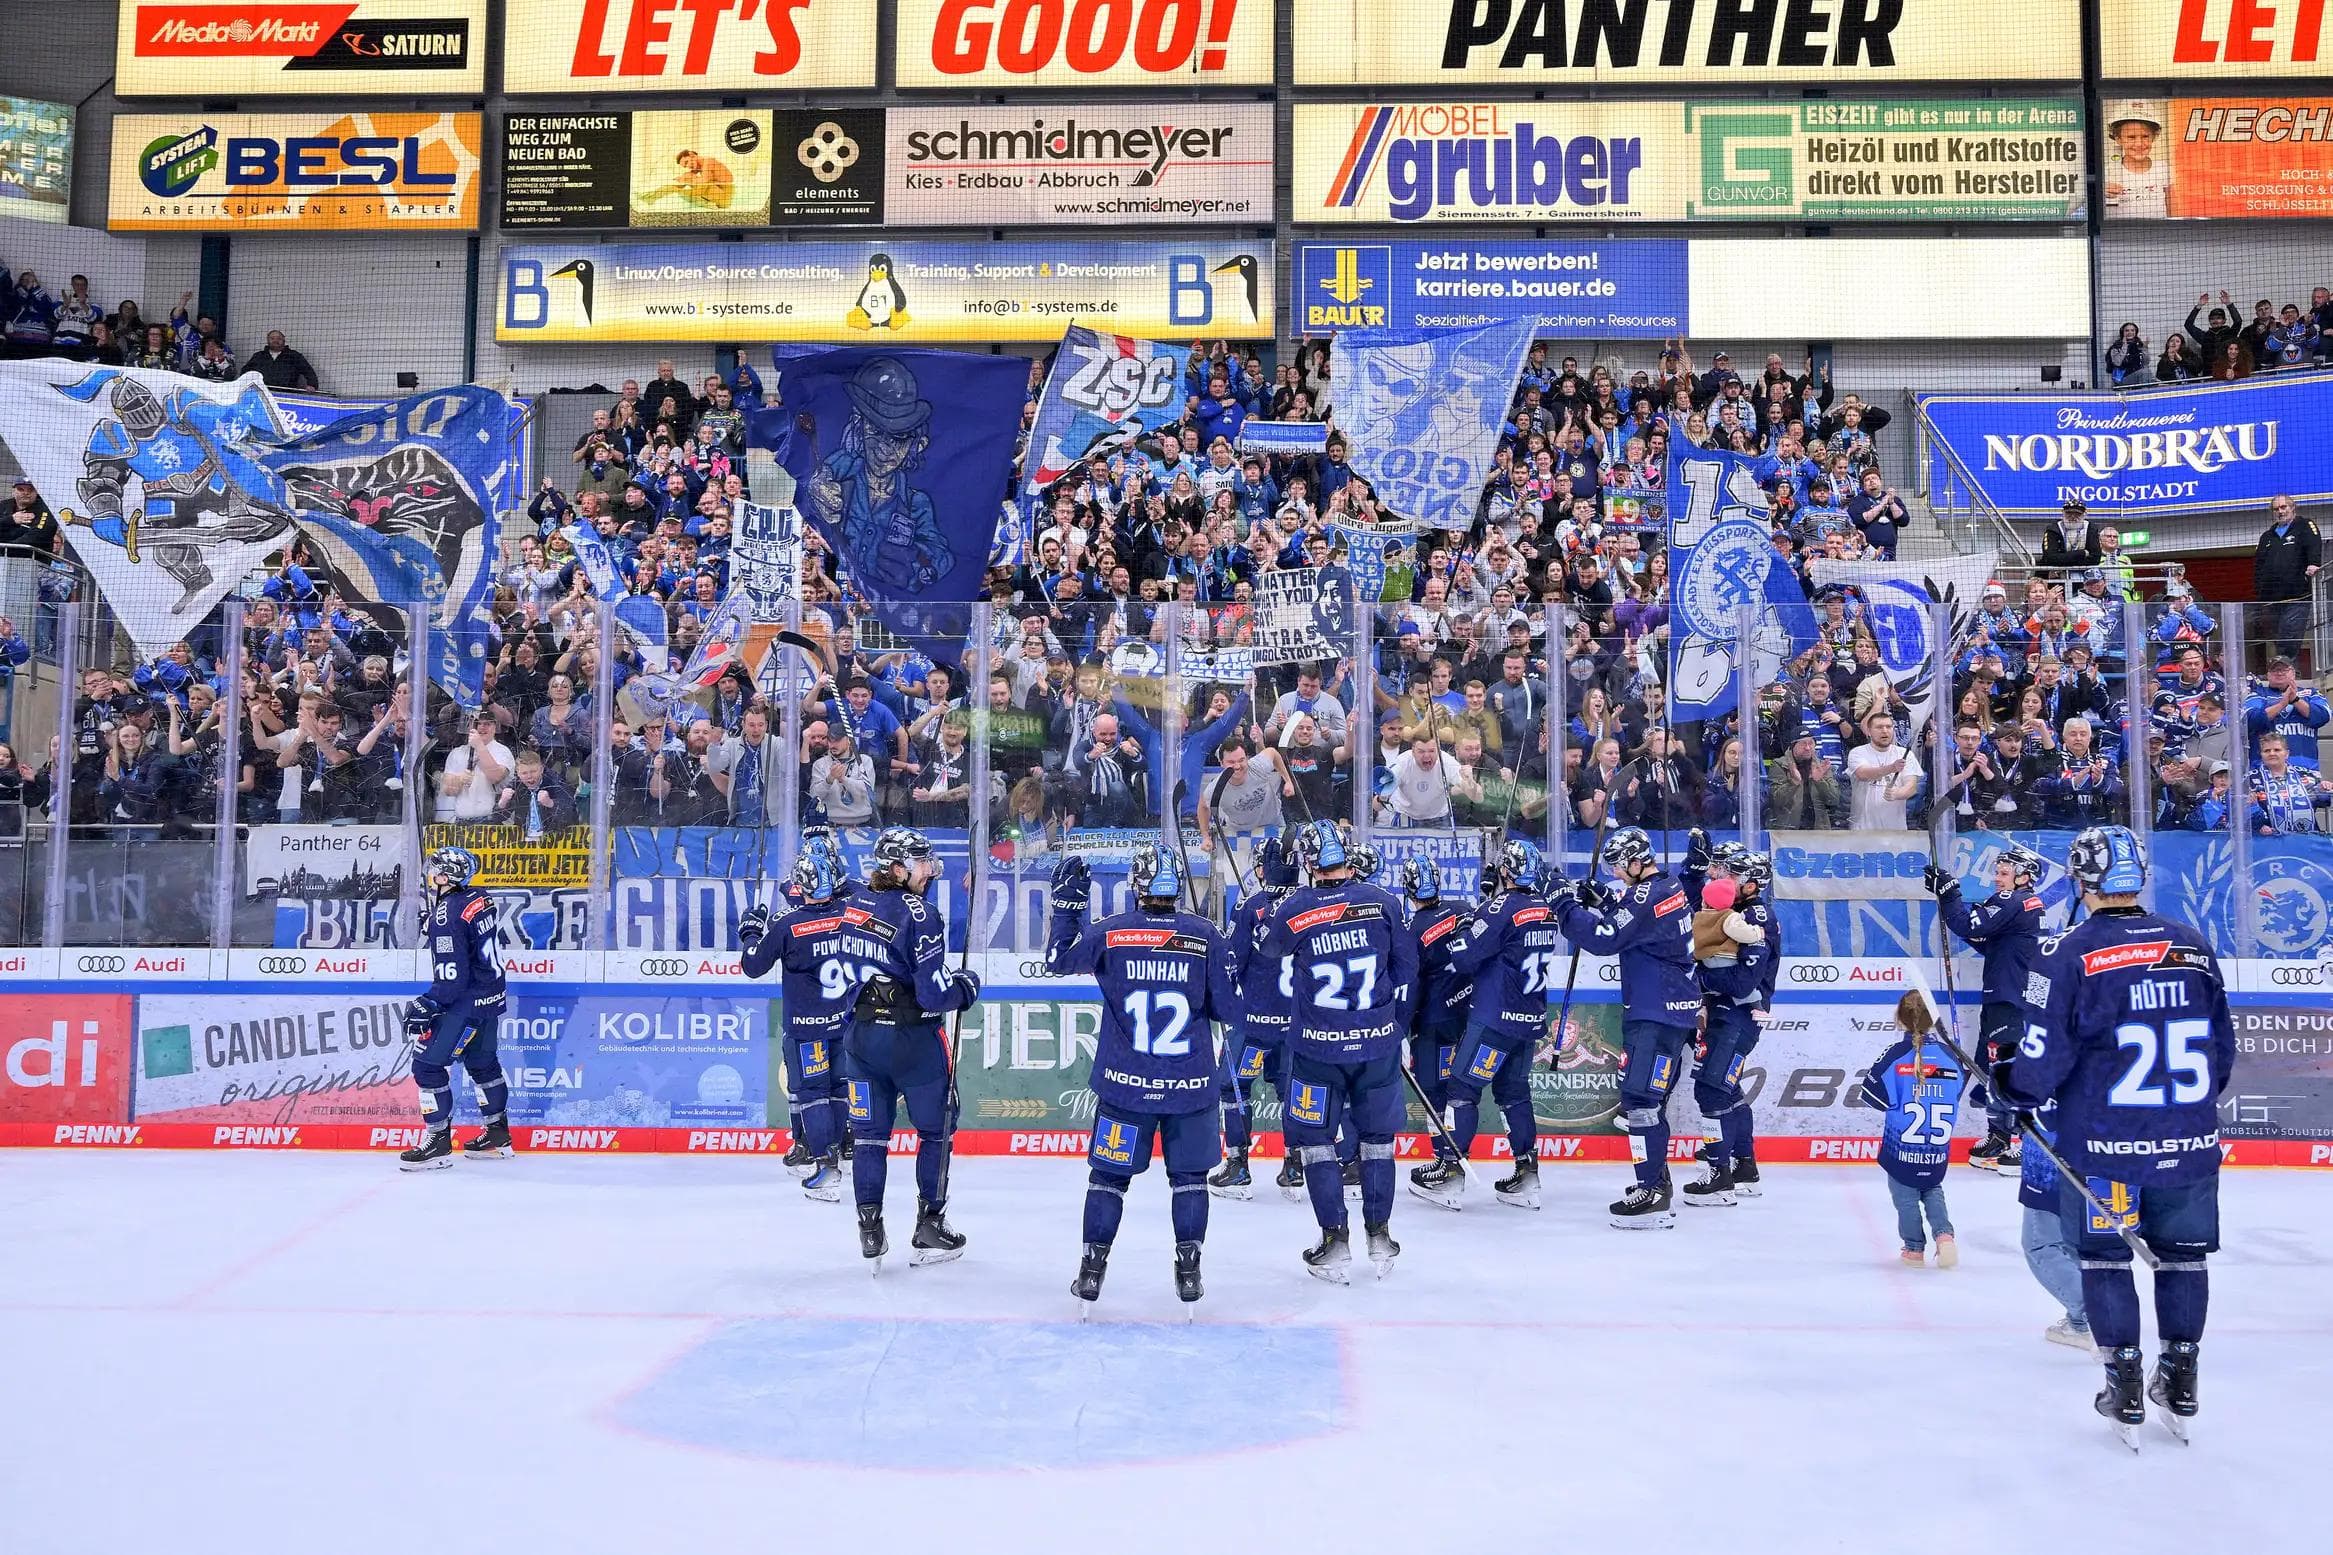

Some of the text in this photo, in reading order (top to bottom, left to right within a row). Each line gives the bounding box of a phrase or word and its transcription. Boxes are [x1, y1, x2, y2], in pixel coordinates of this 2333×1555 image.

[382, 33, 462, 57] SATURN
[570, 0, 810, 77] LET'S
[931, 0, 1236, 75] GOOO!
[1441, 0, 1904, 69] PANTHER
[509, 117, 619, 131] DER EINFACHSTE
[1393, 105, 1509, 136] MÖBEL
[1806, 104, 2077, 127] EISZEIT gibt es nur in der Arena
[2184, 107, 2333, 143] HECH
[508, 132, 572, 146] WEG ZUM
[906, 119, 1233, 174] schmidmeyer
[1807, 136, 2078, 164] Heizöl und Kraftstoffe
[149, 132, 207, 171] SYSTEM
[225, 136, 457, 186] BESL
[508, 147, 587, 161] NEUEN BAD
[175, 154, 208, 182] LIFT
[1386, 122, 1642, 221] gruber
[905, 171, 1120, 189] Kies Erdbau Abbruch
[1807, 168, 2079, 196] direkt vom Hersteller
[2221, 184, 2315, 196] ENTSORGUNG
[795, 186, 860, 199] elements
[1707, 186, 1788, 201] GUNVOR
[142, 202, 457, 217] ARBEITSBÜHNEN & STAPLER
[1054, 195, 1251, 217] www.schmidmeyer.net
[1437, 209, 1642, 219] Siemensstr. 7 Gaimersheim
[906, 262, 1157, 281] Training, Support & Development
[1415, 251, 1598, 271] Jetzt bewerben!
[615, 264, 844, 282] Linux/Open Source Consulting,
[1415, 277, 1616, 297] karriere.bauer.de
[645, 302, 793, 317] www.b1-systems.de
[963, 298, 1119, 316] info@b1-systems.de
[1308, 305, 1386, 327] BAUER
[1608, 312, 1677, 327] Resources
[1061, 344, 1176, 412] ZSC
[2056, 406, 2196, 430] Privatbrauerei
[1983, 420, 2280, 480] NORDBRÄU
[2056, 480, 2199, 503] INGOLSTADT
[1603, 496, 1640, 523] 19
[1337, 513, 1413, 535] Ultra Jugend
[1283, 587, 1313, 606] YOU
[1252, 644, 1322, 663] INGOLSTADT
[280, 835, 381, 852] Panther 64
[1776, 846, 1930, 880] Szene
[1183, 941, 1207, 952] SATURN
[1311, 928, 1369, 956] HÜBNER
[133, 957, 186, 972] Audi
[314, 958, 367, 973] Audi
[435, 962, 458, 981] 16
[504, 959, 554, 974] Audi
[1125, 959, 1190, 983] DUNHAM
[1850, 966, 1903, 982] Audi
[1311, 953, 1378, 1011] 27
[2129, 979, 2190, 1011] HÜTTL
[599, 1011, 751, 1041] KOLIBRI
[1124, 990, 1192, 1056] 12
[1302, 1021, 1395, 1042] INGOLSTADT
[2245, 1015, 2290, 1031] DEN
[205, 1010, 336, 1069] CANDLE
[660, 1045, 676, 1053] und
[718, 1045, 750, 1055] Hygiene
[2261, 1038, 2317, 1054] DICH
[2108, 1017, 2213, 1107] 25
[1104, 1068, 1210, 1090] INGOLSTADT
[1291, 1105, 1321, 1121] BAUER
[1900, 1101, 1954, 1146] 25
[2222, 1127, 2278, 1136] MOBILITY
[1096, 1145, 1130, 1162] BAUER
